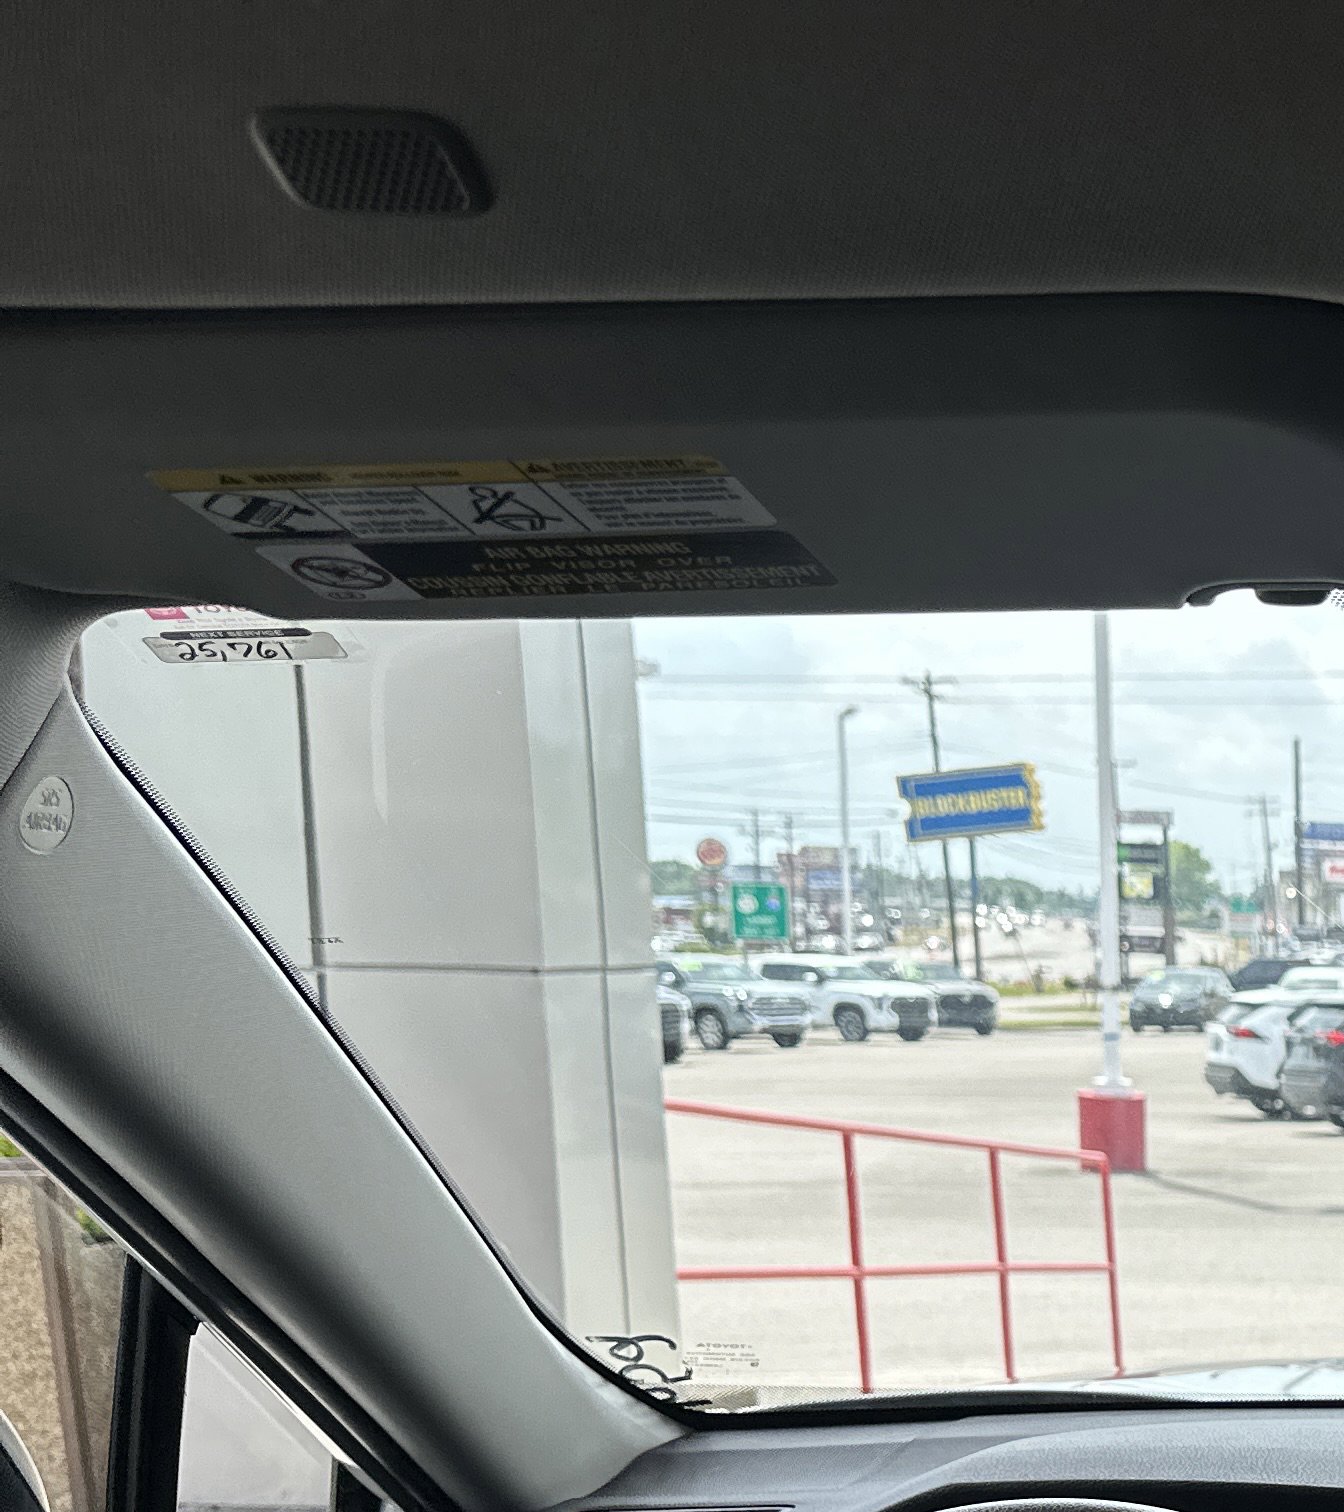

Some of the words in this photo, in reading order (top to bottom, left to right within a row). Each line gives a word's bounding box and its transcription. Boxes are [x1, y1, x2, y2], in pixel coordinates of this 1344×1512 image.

[482, 546, 522, 560] AIR
[525, 545, 570, 560] BAG
[578, 541, 688, 558] WARNING
[471, 562, 530, 574] FLIP
[549, 559, 632, 572] VISOR
[656, 556, 735, 568] OVER
[407, 574, 501, 592] COUSSIN
[507, 571, 639, 588] GONFLABLE
[641, 563, 823, 581] AVERTISSEMENT
[190, 630, 223, 640] NEXT
[227, 628, 288, 639] SERVICE
[174, 640, 294, 663] 25,761
[916, 787, 1028, 818] BLOCKBUSTER
